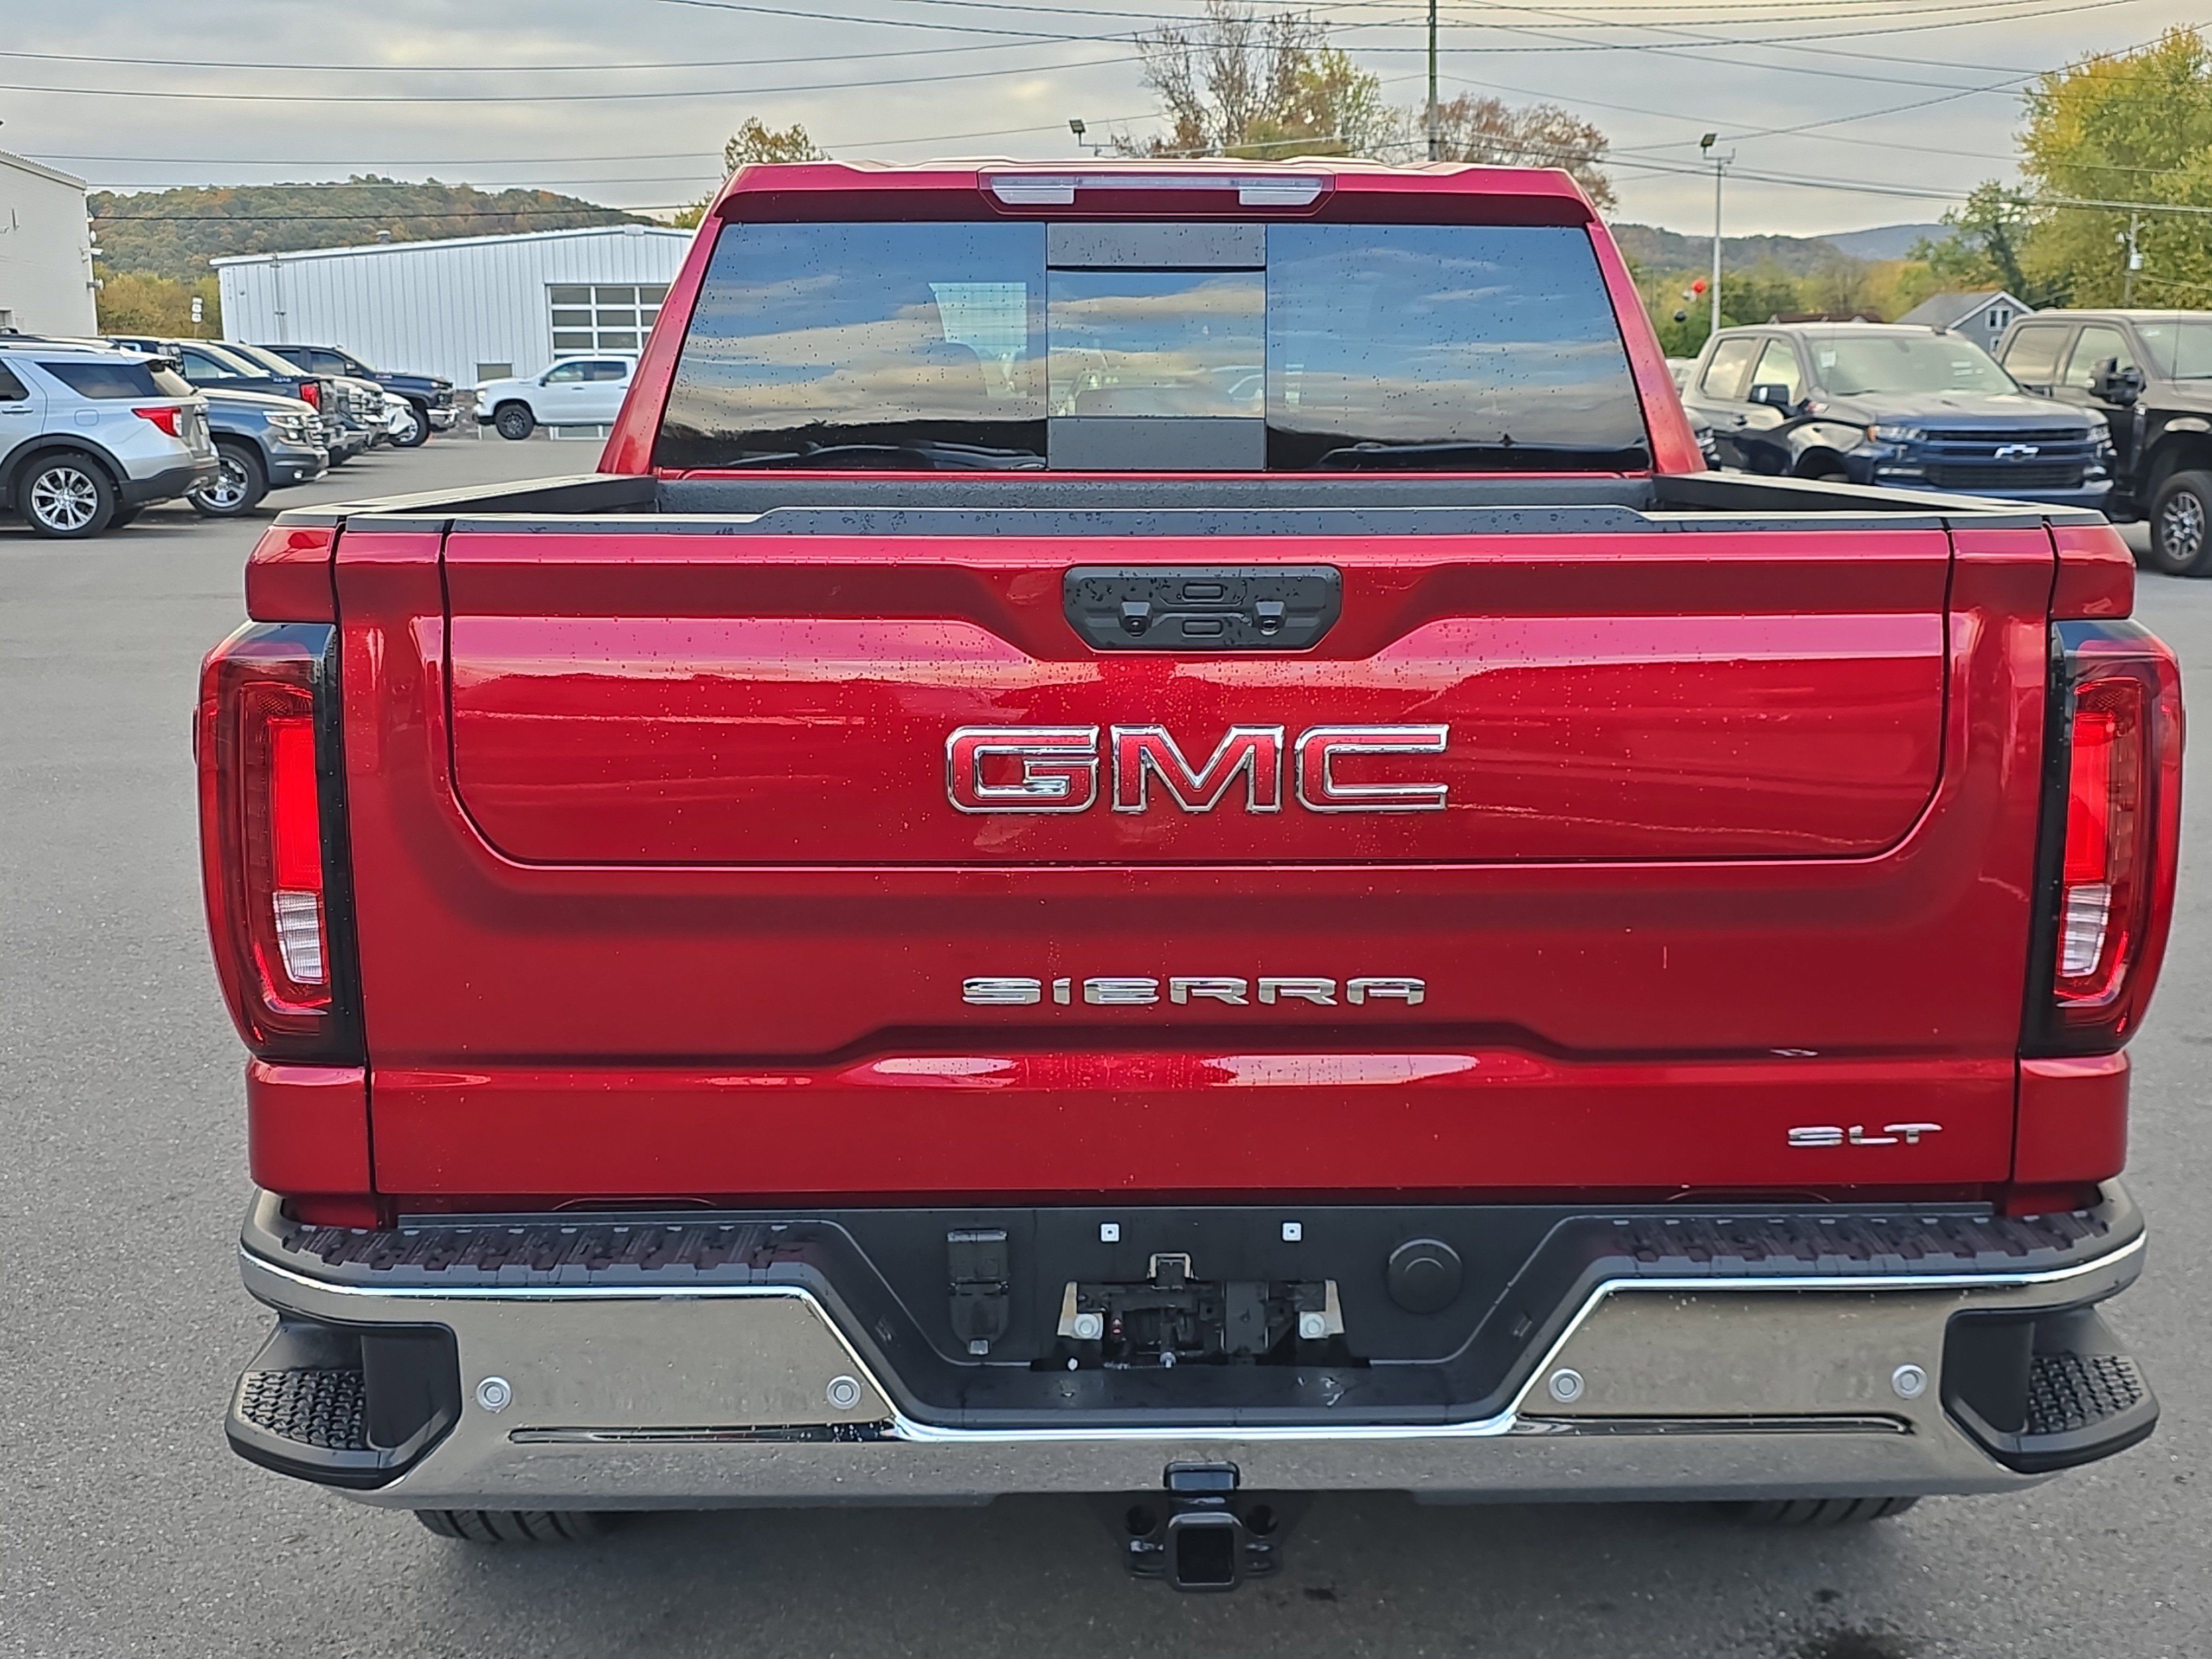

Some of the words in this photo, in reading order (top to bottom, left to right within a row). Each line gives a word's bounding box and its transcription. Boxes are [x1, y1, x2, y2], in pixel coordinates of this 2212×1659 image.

[944, 724, 1449, 813] GMC
[962, 977, 1426, 1005] SIERRA
[1787, 1123, 1943, 1146] SLT
